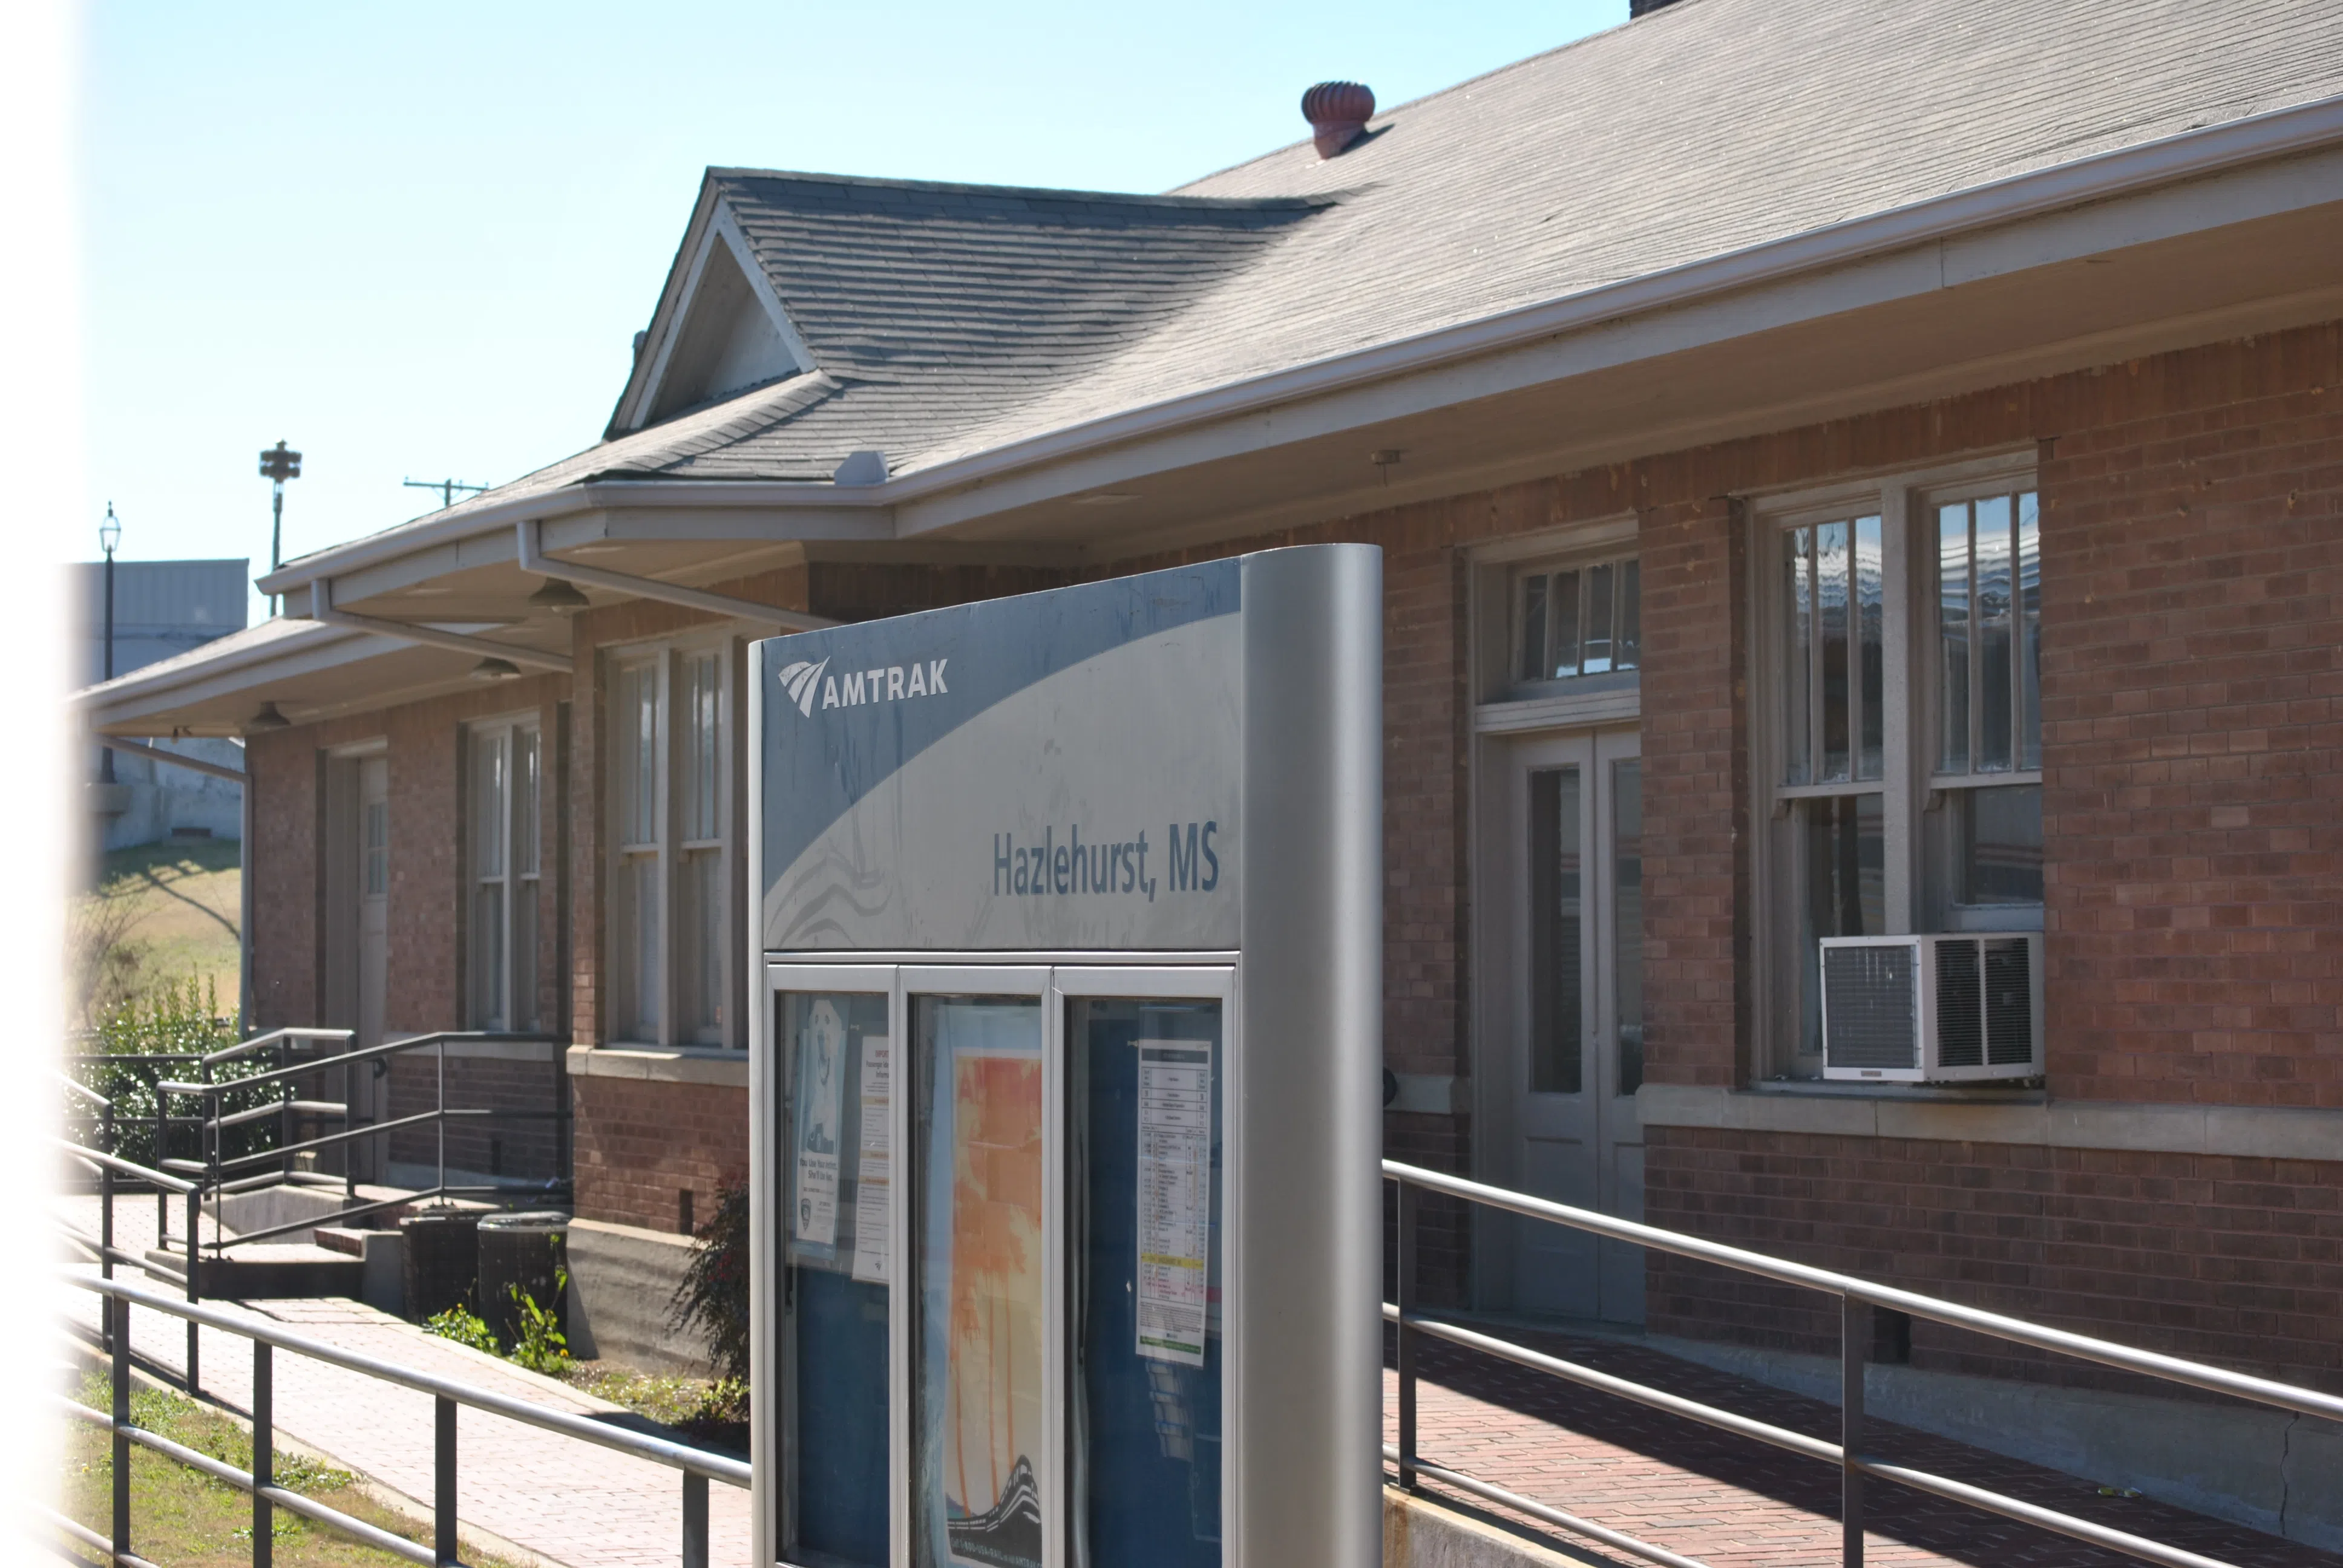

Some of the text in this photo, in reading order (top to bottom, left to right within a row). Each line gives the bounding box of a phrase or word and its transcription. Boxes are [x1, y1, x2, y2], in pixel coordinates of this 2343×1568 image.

[822, 659, 948, 710] AMTRAK
[994, 820, 1219, 903] Hazlehurst, MS
